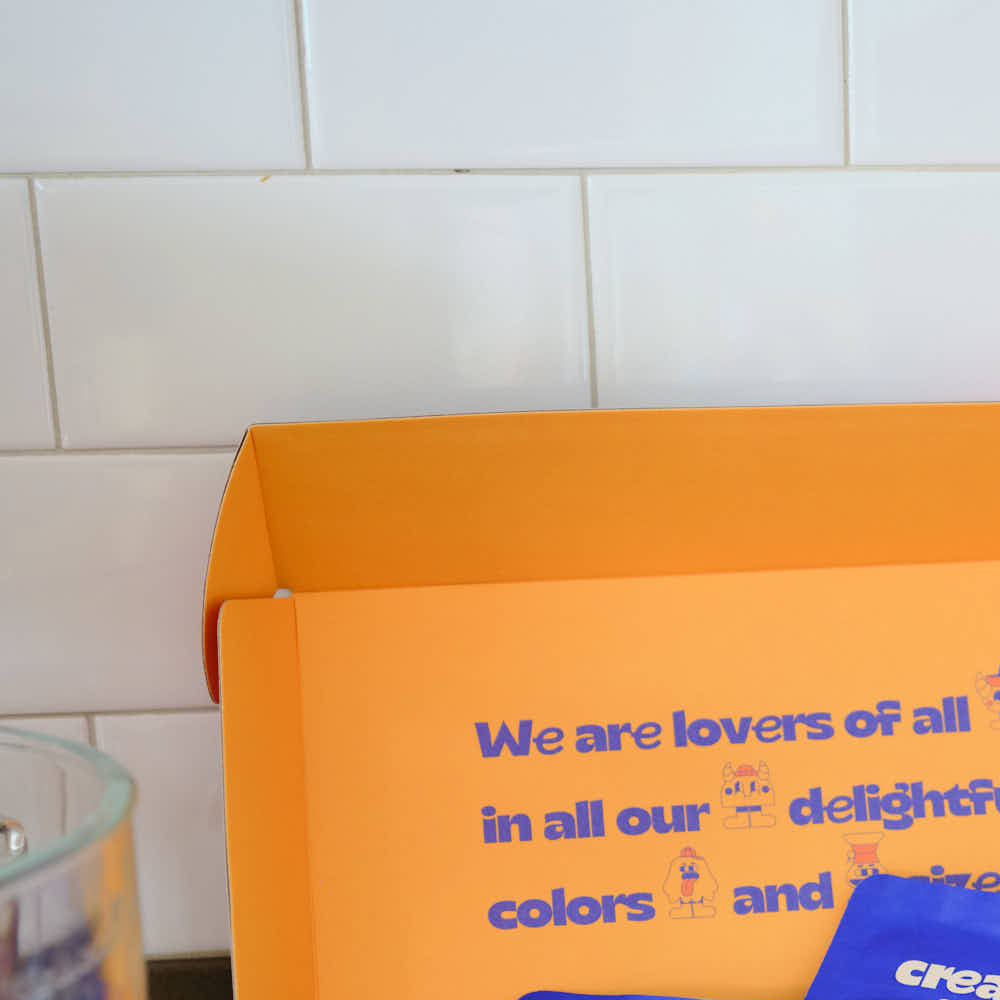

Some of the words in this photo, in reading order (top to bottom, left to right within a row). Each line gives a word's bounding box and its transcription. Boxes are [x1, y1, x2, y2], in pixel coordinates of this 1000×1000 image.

[475, 719, 564, 758] We
[575, 721, 662, 754] are
[672, 710, 835, 748] lovers
[844, 700, 901, 738] of
[912, 695, 971, 735] all
[480, 805, 533, 844] in
[544, 799, 605, 841] all
[616, 802, 711, 836] our
[487, 888, 657, 930] colors
[733, 871, 835, 915] and
